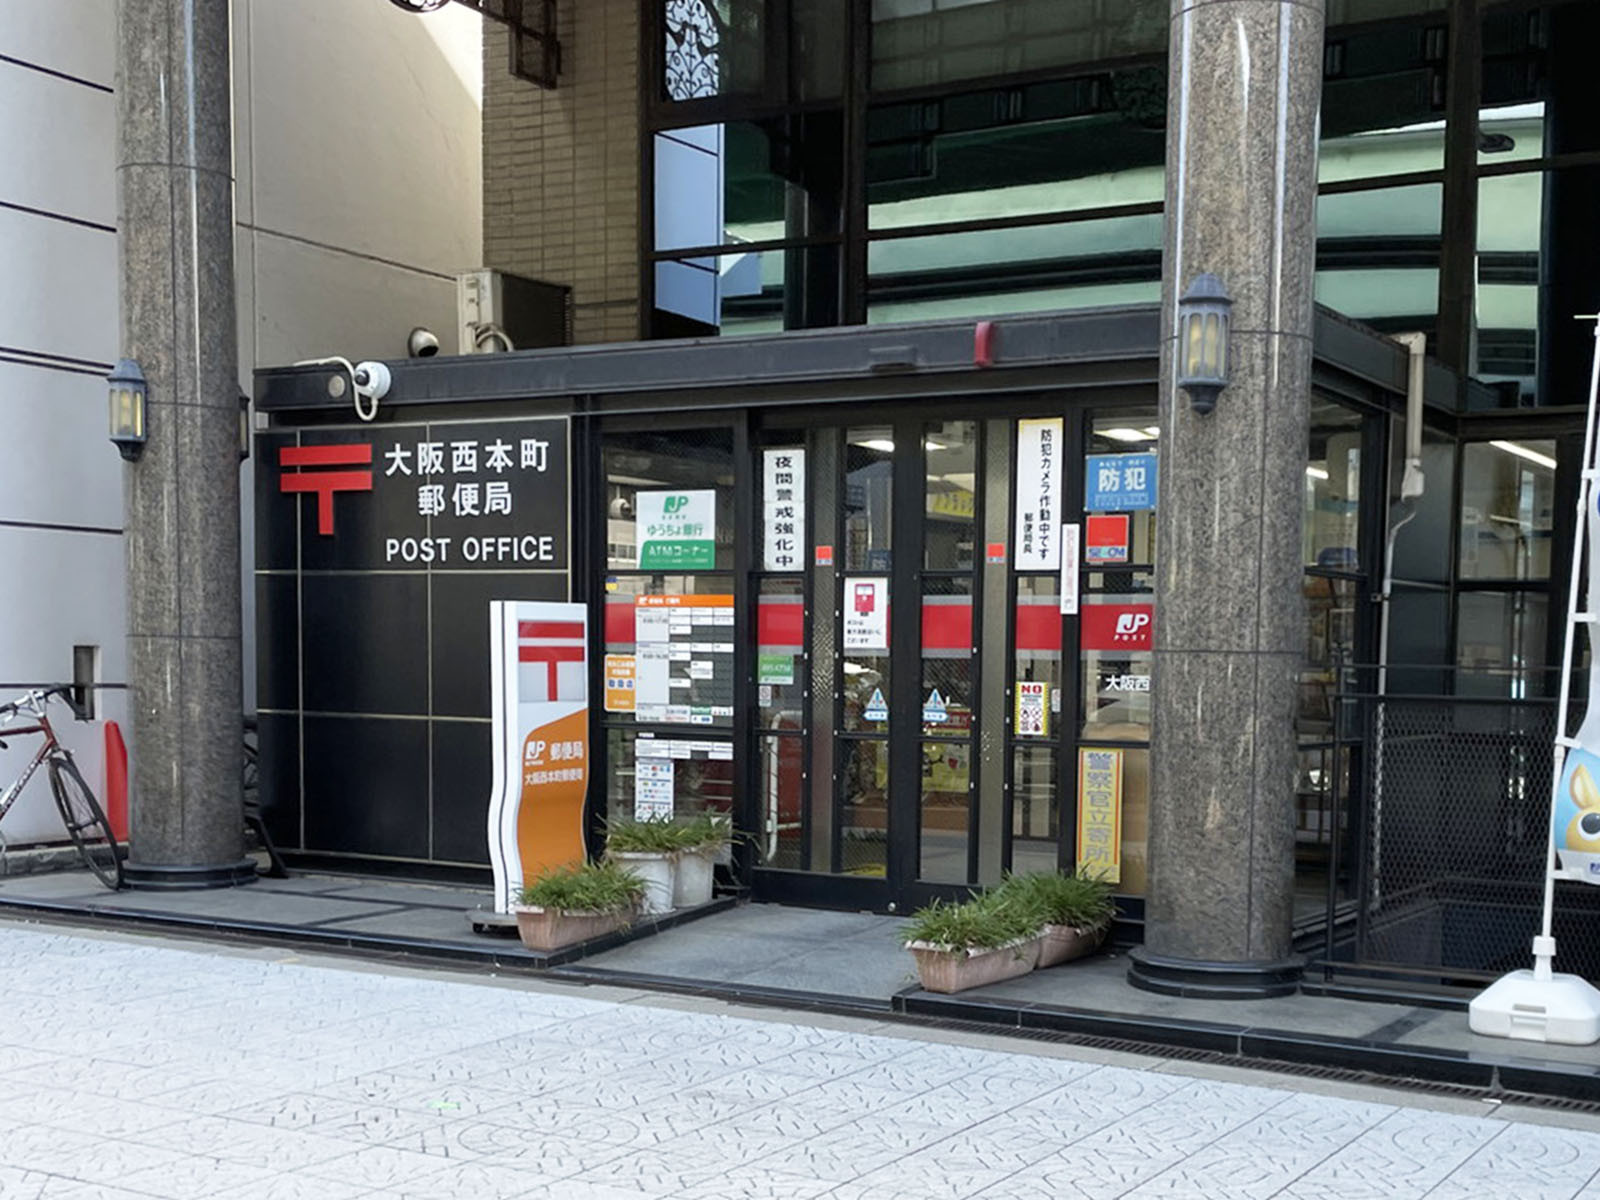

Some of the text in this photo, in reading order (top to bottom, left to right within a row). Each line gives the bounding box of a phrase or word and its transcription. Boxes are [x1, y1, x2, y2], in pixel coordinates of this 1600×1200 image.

[384, 438, 550, 477] 大阪西本町
[1098, 467, 1146, 492] 防犯
[417, 481, 513, 517] 郵便局
[663, 496, 689, 514] JP
[774, 455, 795, 567] 夜間警戒強化中
[386, 535, 554, 562] POST OFFICE
[649, 544, 709, 557] ATMコーナー
[1115, 613, 1149, 634] JP
[1021, 684, 1042, 694] NO
[525, 740, 546, 760] JP
[550, 740, 583, 761] 郵便局
